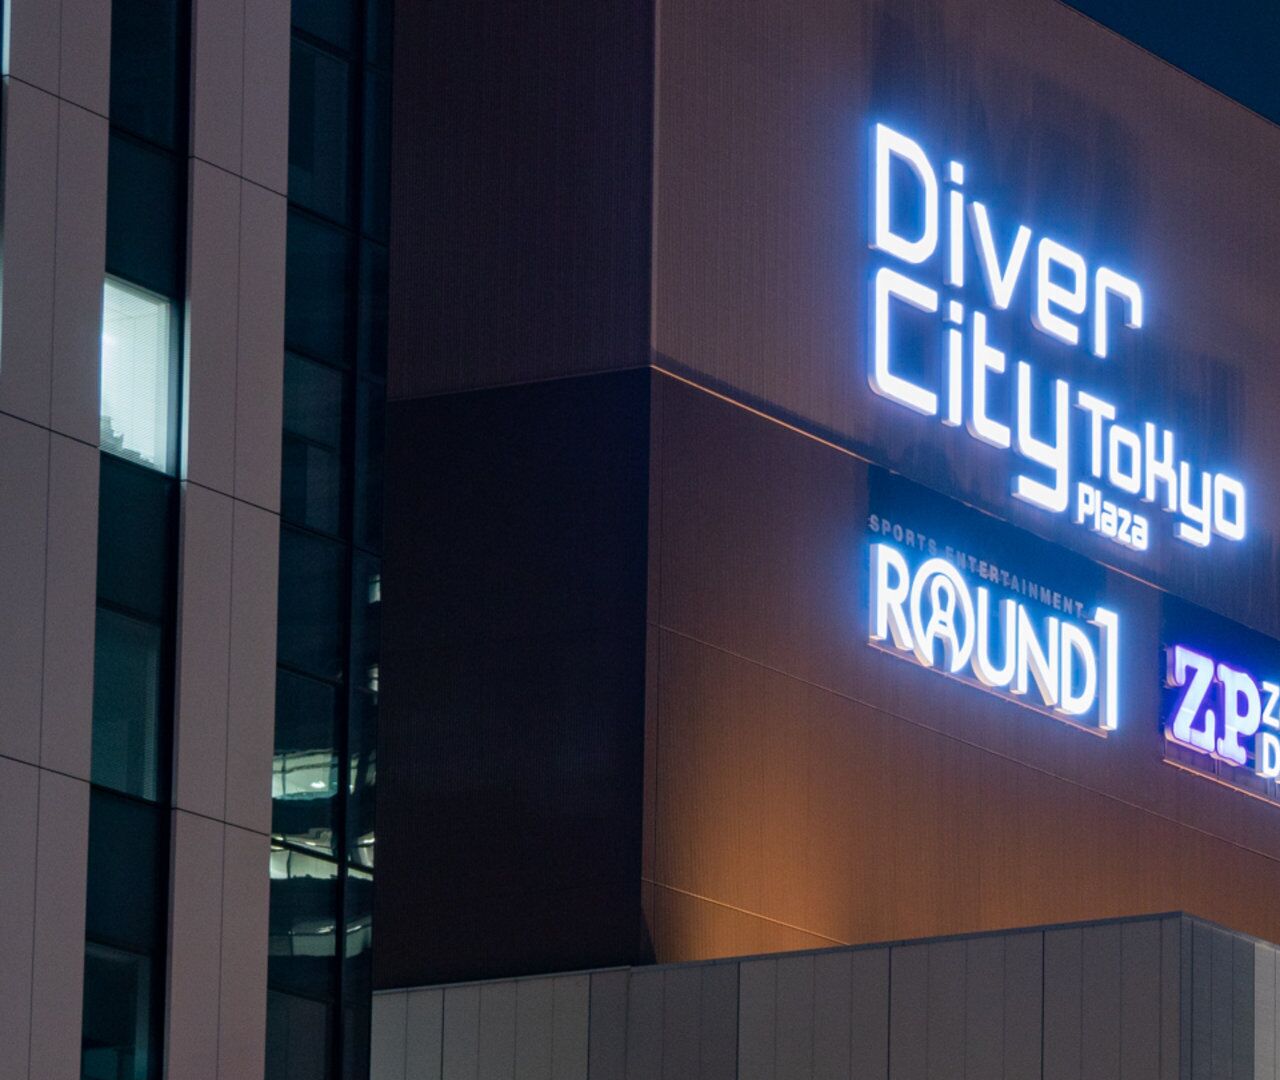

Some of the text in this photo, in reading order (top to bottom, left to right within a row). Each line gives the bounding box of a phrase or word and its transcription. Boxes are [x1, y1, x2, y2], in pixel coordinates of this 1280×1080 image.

[872, 122, 1142, 358] Diver
[870, 266, 1069, 513] City
[869, 513, 1085, 620] SPORTS ENTERTAINMENT
[1075, 481, 1149, 551] Plaza
[1166, 645, 1262, 766] ZP
